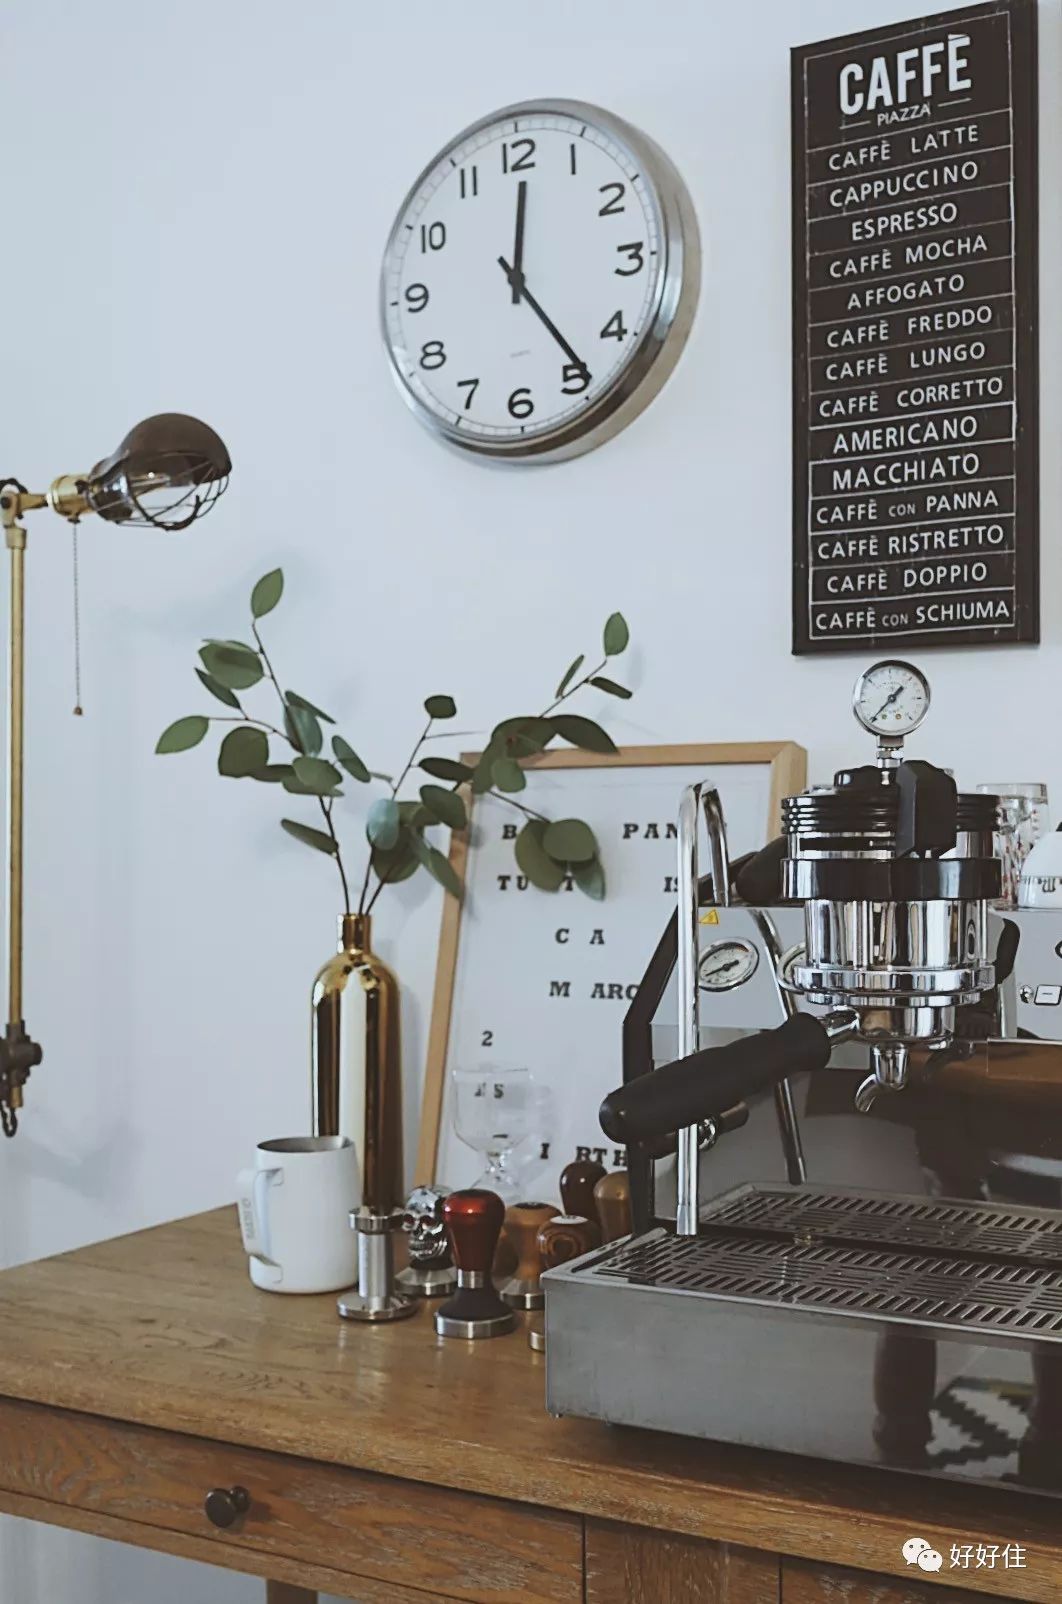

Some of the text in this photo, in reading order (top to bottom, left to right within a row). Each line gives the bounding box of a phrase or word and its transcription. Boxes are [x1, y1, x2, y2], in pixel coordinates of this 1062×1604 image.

[840, 34, 971, 115] CAFFÈ
[877, 103, 931, 127] PIAZZA
[502, 138, 536, 174] 12
[570, 143, 577, 176] 1
[828, 125, 979, 171] CAFFÈ LATTE
[460, 166, 477, 199] 11
[598, 182, 625, 216] 2
[829, 161, 978, 208] CAPPUCCINO
[421, 221, 446, 253] 10
[852, 202, 957, 241] ESPRESSO
[614, 241, 643, 276] 3
[829, 234, 988, 279] CAFFÈ MOCHA
[404, 283, 429, 313] 9
[847, 273, 965, 311] AFFOGATO
[600, 310, 627, 341] 4
[827, 305, 992, 348] CAFFÈ FREDDO
[419, 341, 446, 371] 8
[826, 341, 985, 380] CAFFÈ LUNGO
[457, 378, 480, 410] 7
[560, 362, 590, 395] 5
[508, 388, 534, 419] 6
[819, 377, 1002, 417] CAFFÈ CORRETTO
[832, 415, 977, 454] AMERICANO
[832, 453, 979, 491] MACCHIATO
[816, 490, 998, 524] CAFFÈ CON PANNA
[818, 524, 1003, 560] CAFFÈ RISTRETTO
[827, 562, 987, 593] CAFFÈ DOPPIO
[816, 600, 1009, 630] CAFFÈ CON SCHIUMA
[481, 1030, 494, 1047] 2
